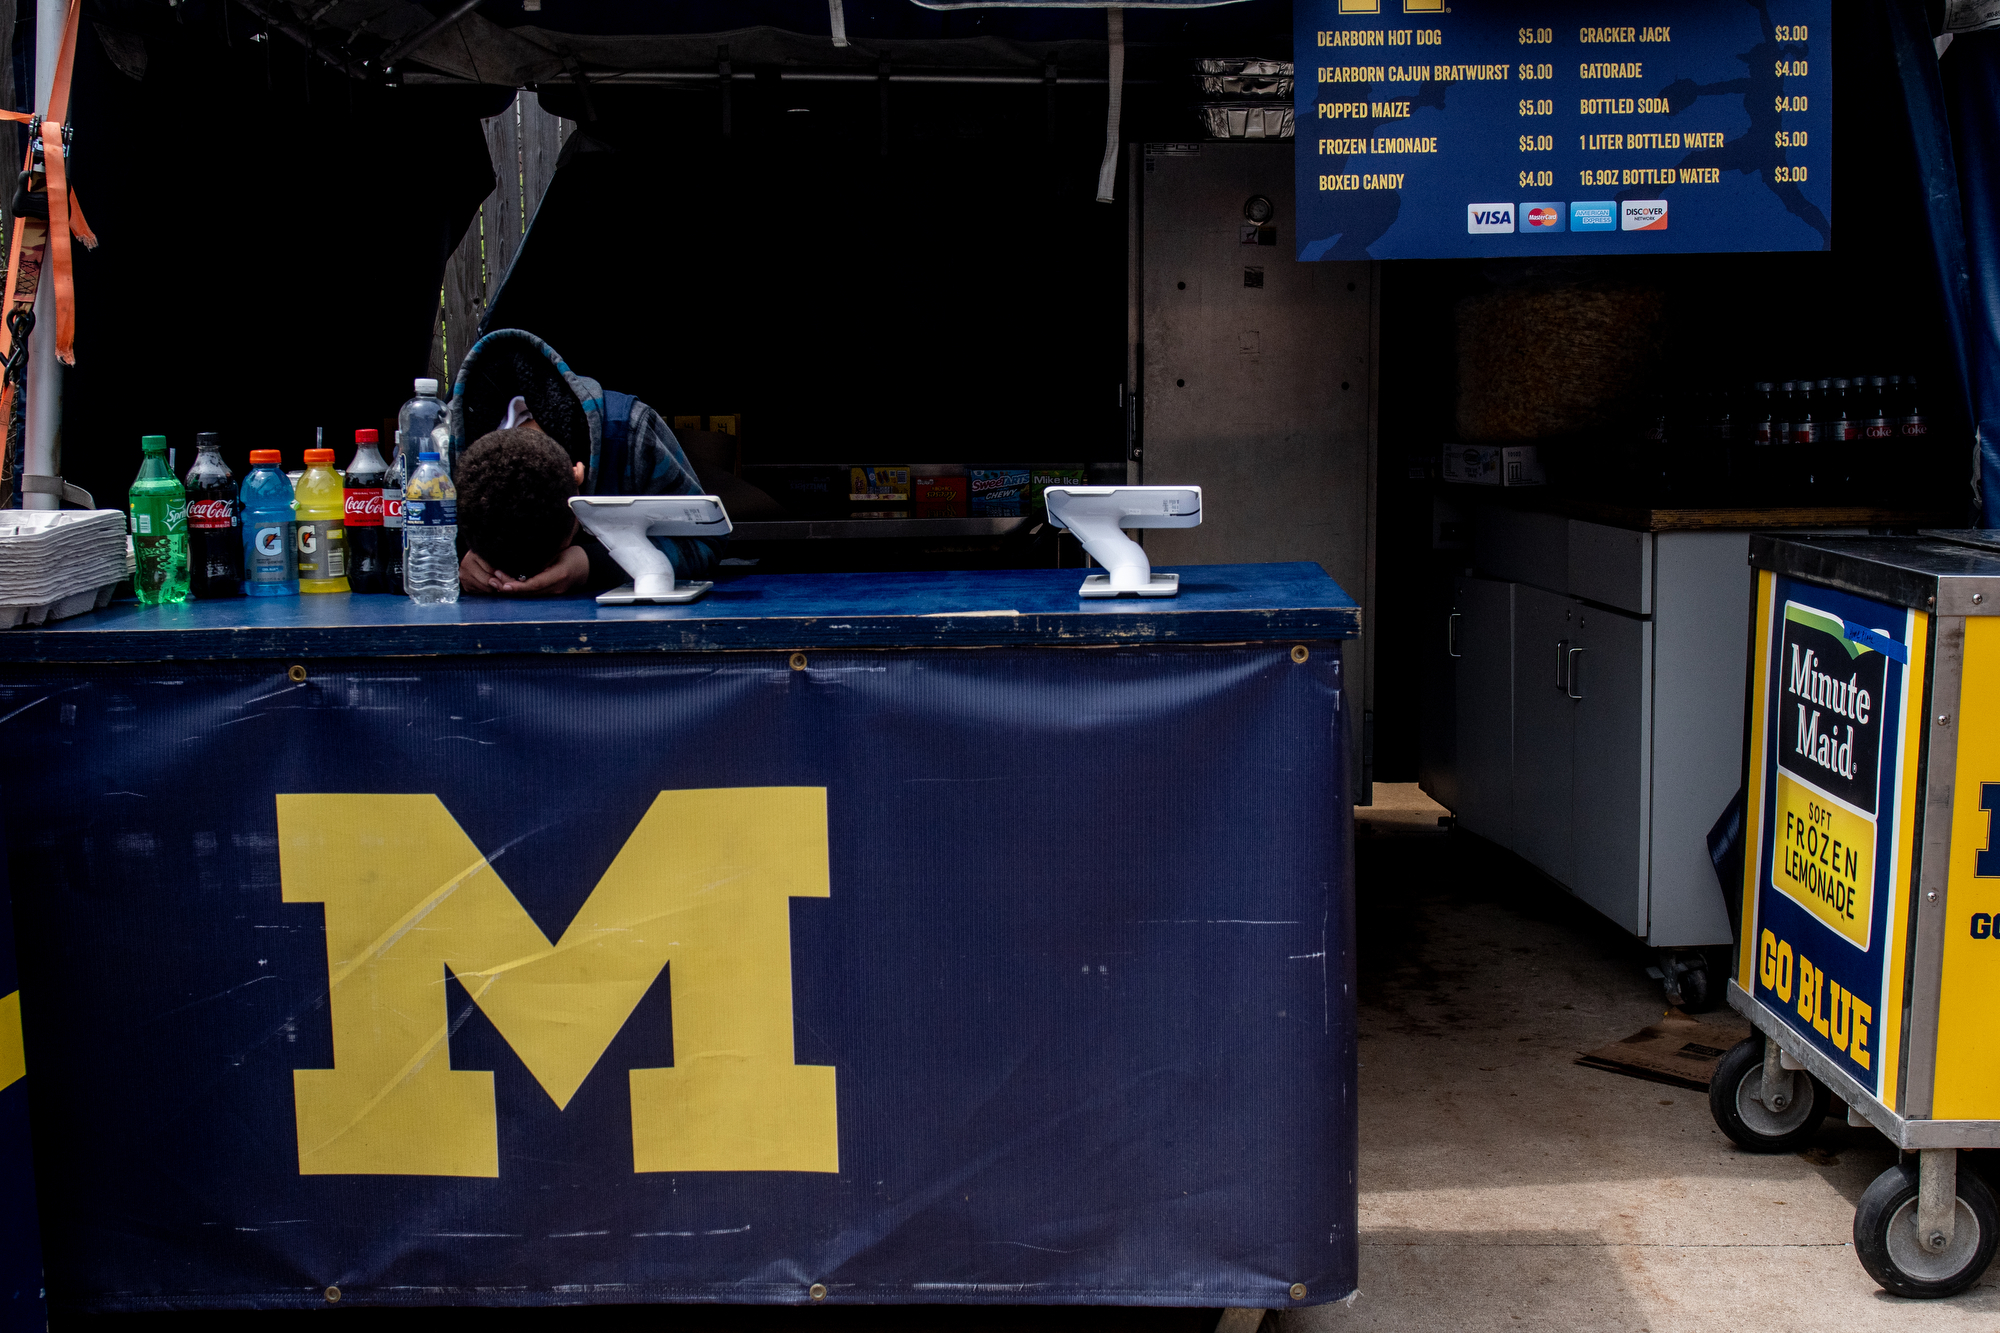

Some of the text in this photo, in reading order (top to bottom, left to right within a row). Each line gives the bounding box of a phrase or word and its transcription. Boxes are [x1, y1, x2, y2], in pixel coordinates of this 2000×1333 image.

[1318, 28, 1552, 46] DEARBORN HOT DOG $5.00
[1581, 25, 1807, 42] CRACKER JACK $3.00
[1319, 64, 1552, 82] DEARBORN CAJUN BRATWURST $6.00
[1581, 61, 1807, 78] GATORADE $4.00
[1319, 99, 1552, 118] POPPED MAIZE $5.00
[1581, 96, 1807, 114] BOTTLED SODA $4.00
[1319, 135, 1552, 154] FROZEN LEMONADE $5.00
[1580, 131, 1807, 149] 1 LITER BOTTLED WATER $5.00
[1320, 171, 1552, 190] BOXED CANDY $4.00
[1580, 166, 1807, 185] 16.9OZ BOTTLED WATER $3.00
[1472, 210, 1512, 224] VISA
[1528, 213, 1557, 221] MasterCard
[1575, 209, 1610, 217] AMERICAN
[1583, 216, 1612, 224] EXPRESS
[1626, 207, 1663, 216] DISCOVER
[1866, 426, 1892, 438] Coke
[1901, 423, 1928, 435] Coke
[1033, 475, 1080, 485] Mike Ike
[985, 488, 1018, 500] CHEWY
[186, 499, 234, 518] Coca-Cola
[345, 496, 384, 514] Coca-Col
[255, 527, 282, 555] G
[297, 525, 317, 554] G
[1788, 642, 1871, 725] Minute
[1808, 801, 1832, 830] SOFT
[1787, 811, 1858, 882] FROZEN
[1785, 845, 1856, 920] LEMONADE
[275, 786, 839, 1178] M
[1759, 928, 1872, 1070] GO BLUE
